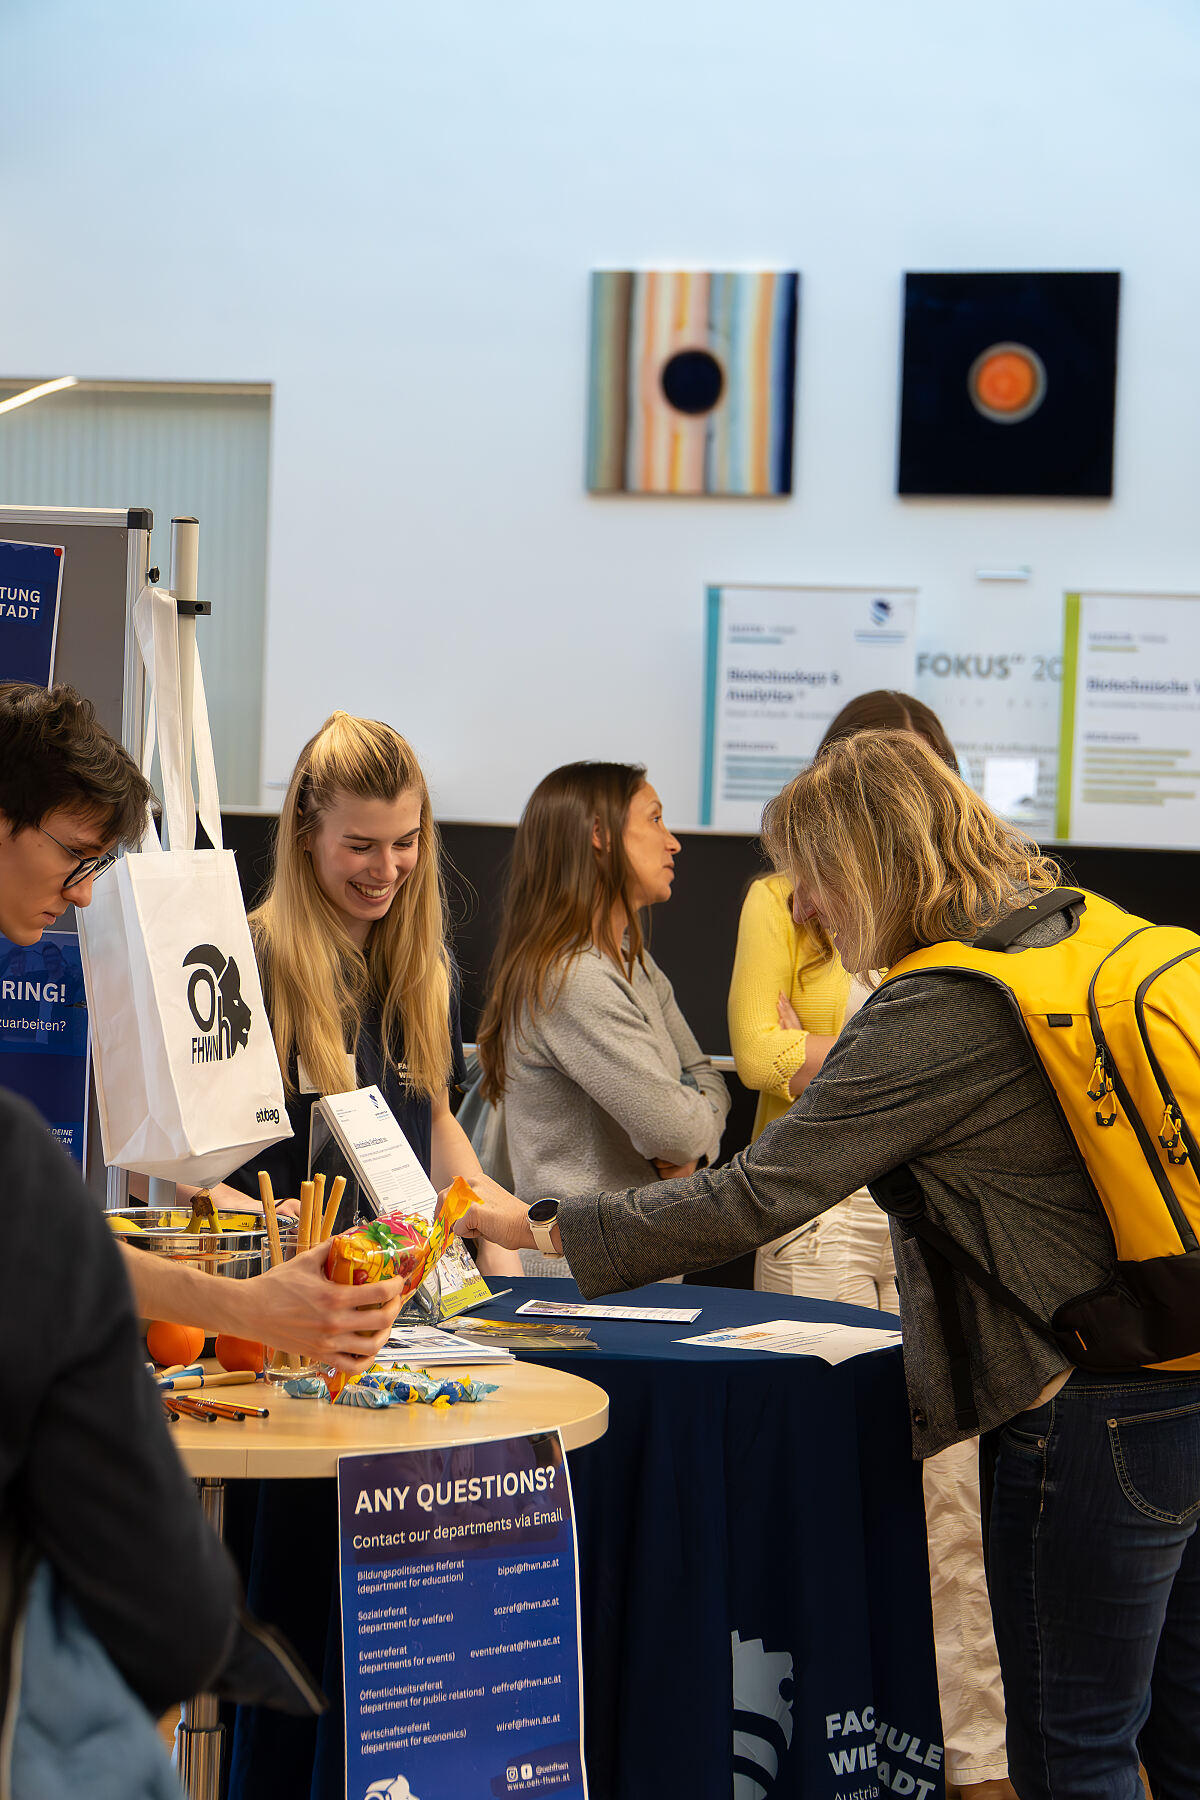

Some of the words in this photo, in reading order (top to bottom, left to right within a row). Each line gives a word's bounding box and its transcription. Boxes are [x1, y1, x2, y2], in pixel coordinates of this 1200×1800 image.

[2, 980, 66, 1003] RING!
[51, 1128, 74, 1137] DEINE
[354, 1486, 410, 1515] ANY
[416, 1465, 556, 1512] QUESTIONS?
[353, 1531, 406, 1550] Contact
[408, 1528, 431, 1543] our
[433, 1516, 512, 1540] departments
[515, 1513, 531, 1528] via
[533, 1507, 563, 1526] Email
[357, 1563, 435, 1581] Bildungspolitisches
[436, 1559, 465, 1572] Referat
[357, 1579, 407, 1595] (department
[409, 1578, 421, 1588] for
[422, 1572, 464, 1586] education)
[357, 1606, 408, 1622] Sozialreferat
[358, 1619, 407, 1635] (department
[409, 1617, 421, 1627] for
[422, 1611, 454, 1626] welfare)
[359, 1645, 408, 1661] Eventreferat
[359, 1658, 412, 1675] (departments
[413, 1656, 425, 1667] for
[426, 1652, 455, 1665] events)
[360, 1680, 443, 1701] Öffentlichkeitsreferat
[360, 1699, 408, 1715] (department
[409, 1696, 421, 1707] for
[423, 1692, 447, 1707] public
[448, 1686, 485, 1701] relations)
[360, 1721, 431, 1741] Wirtschaftsreferat
[361, 1738, 409, 1755] (department
[410, 1735, 421, 1746] for
[423, 1728, 467, 1744] economics)
